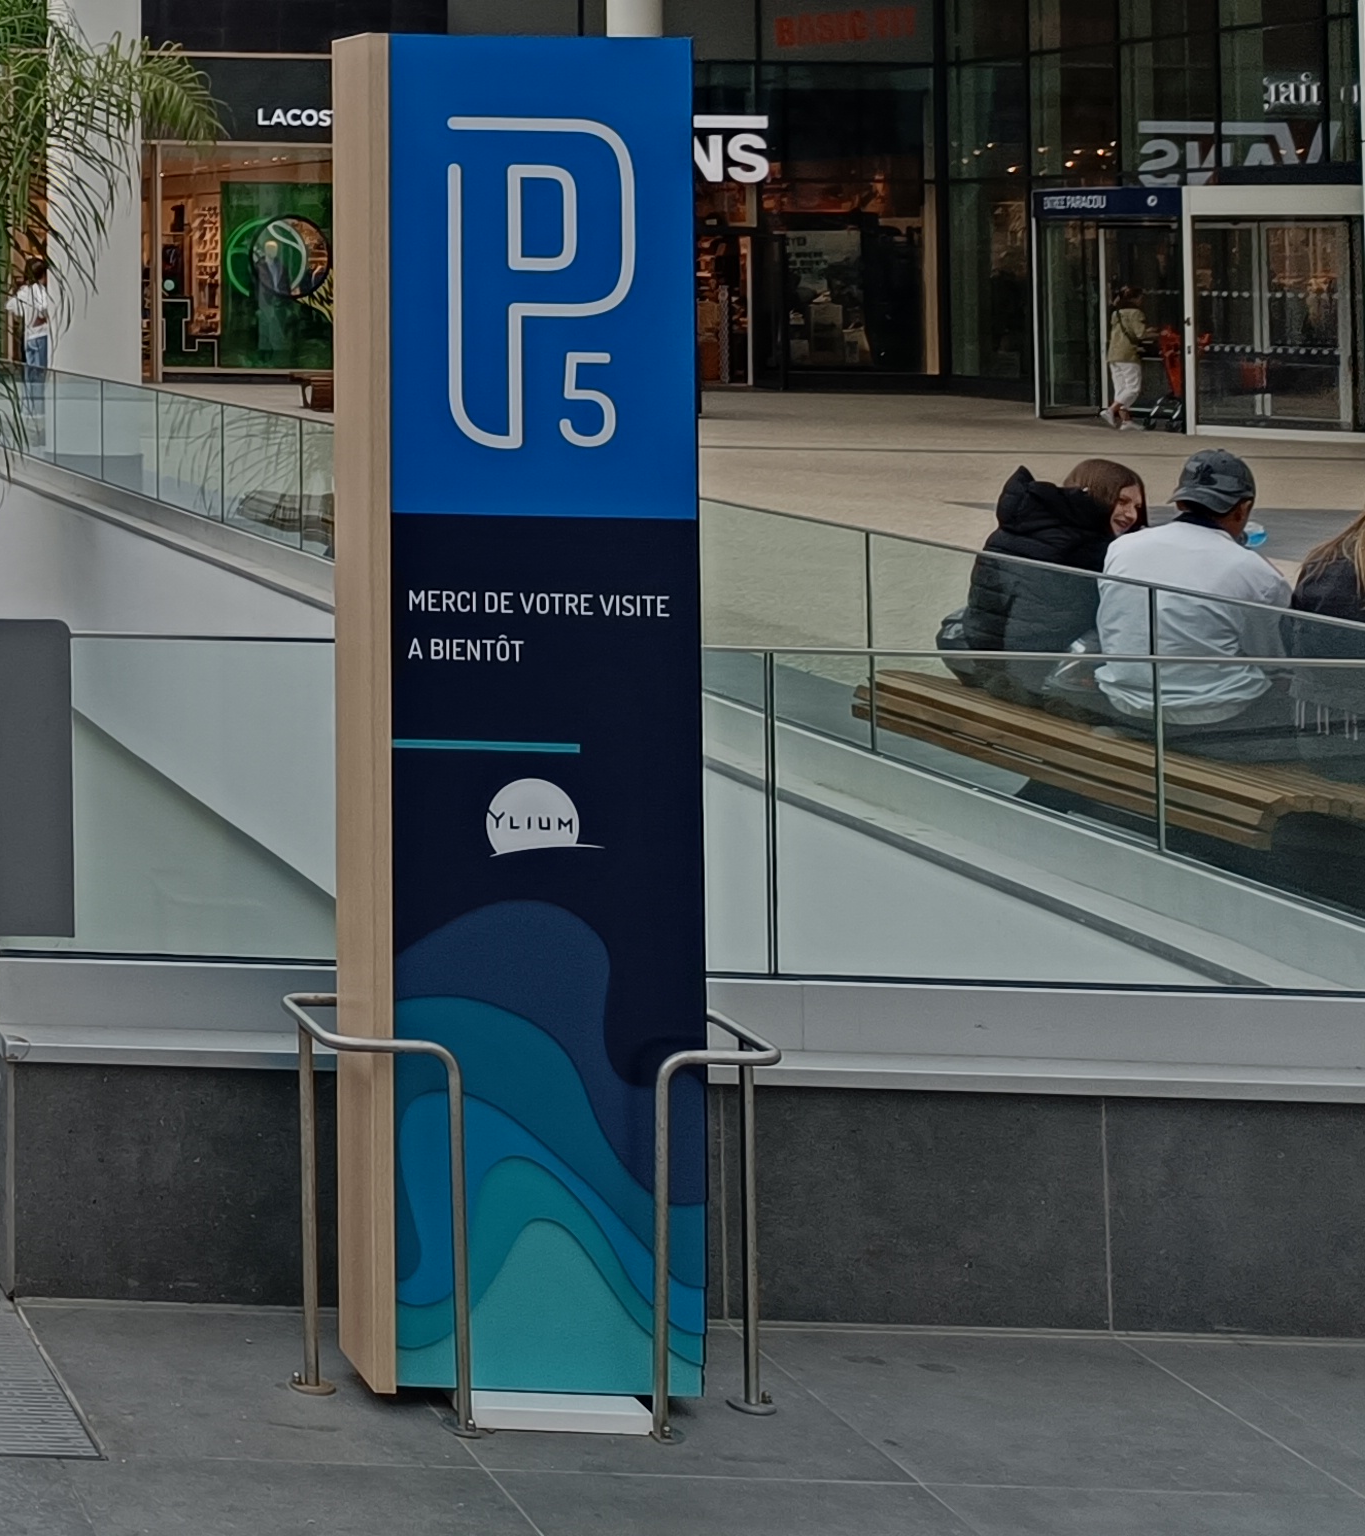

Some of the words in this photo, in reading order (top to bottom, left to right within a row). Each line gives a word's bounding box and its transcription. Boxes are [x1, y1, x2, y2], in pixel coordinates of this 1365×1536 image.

[257, 107, 334, 128] LACOS
[693, 132, 770, 184] NS
[408, 589, 477, 613] MERCI
[484, 591, 514, 614] DE
[519, 592, 594, 616] VOTRE
[599, 594, 670, 618] VISITE
[407, 637, 423, 660] A
[430, 634, 524, 663] BIENTÔT
[488, 809, 573, 835] YLIUM
